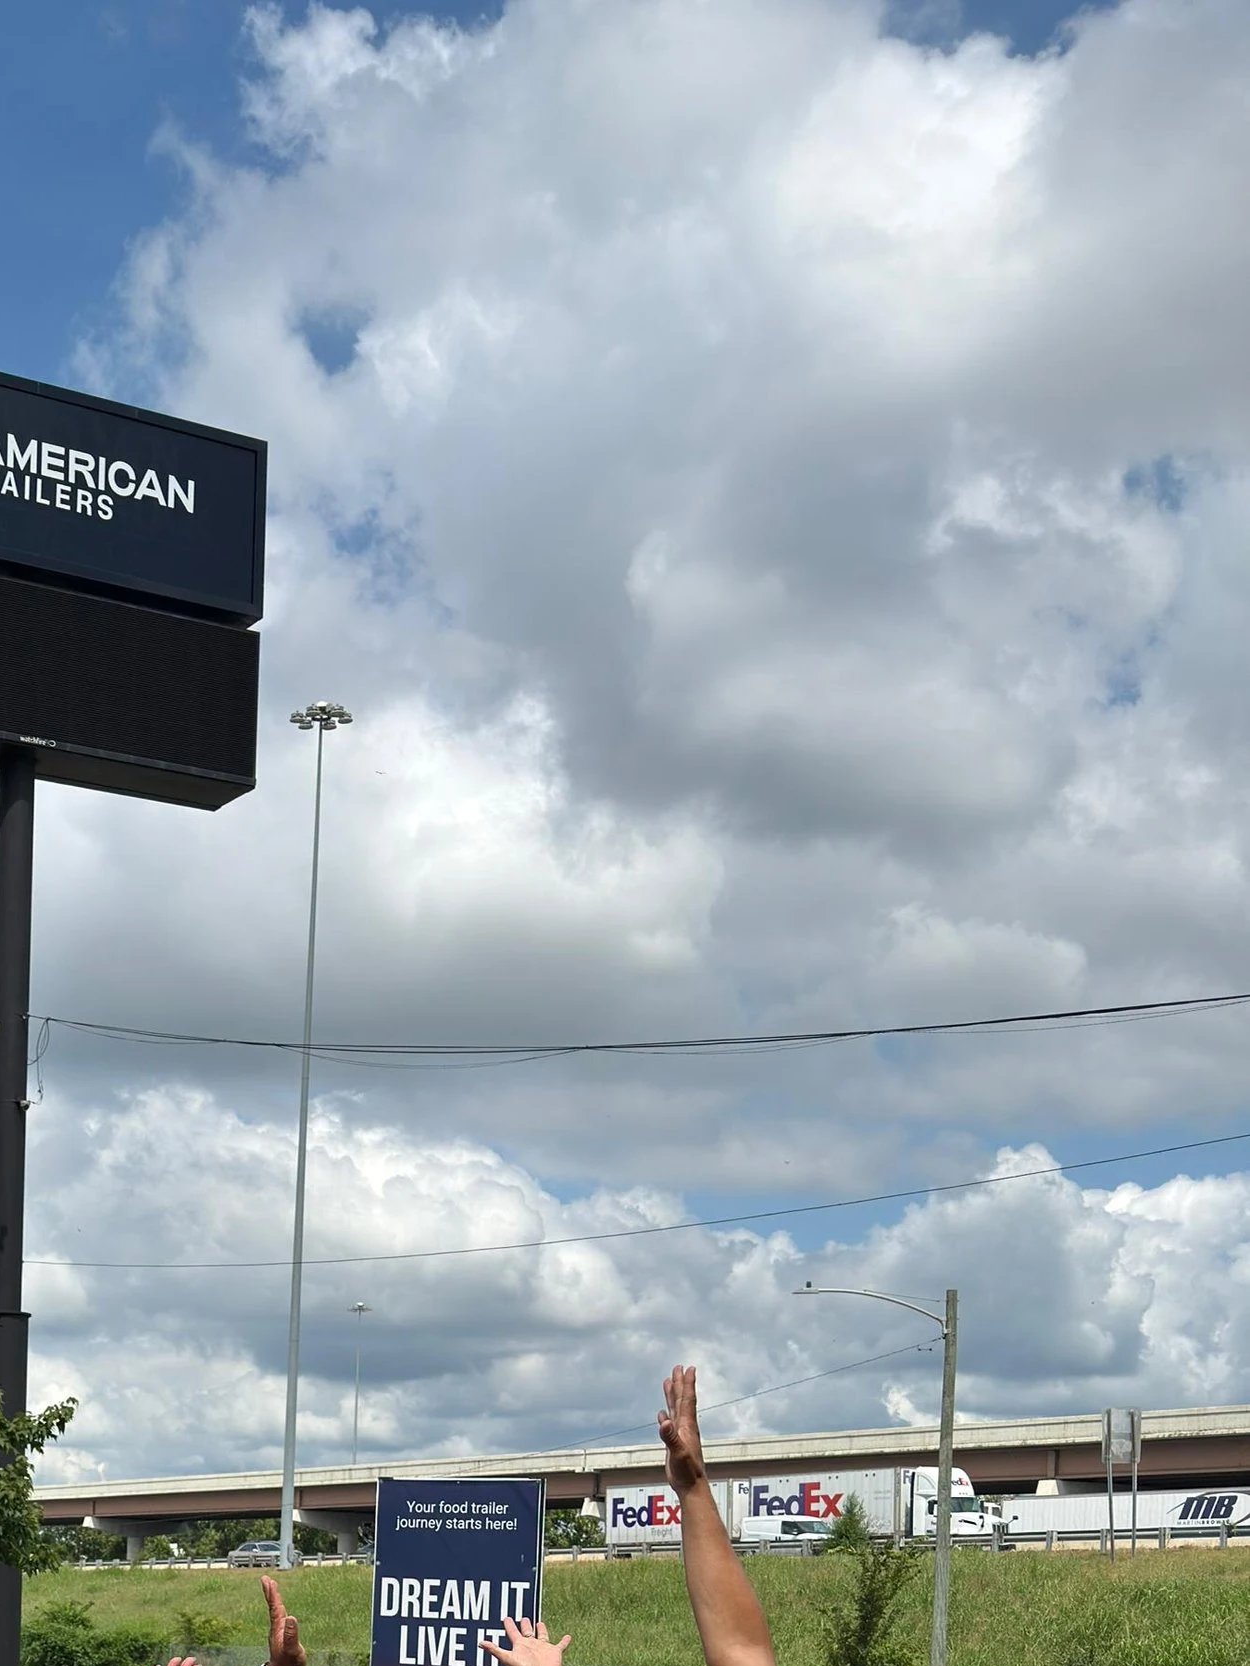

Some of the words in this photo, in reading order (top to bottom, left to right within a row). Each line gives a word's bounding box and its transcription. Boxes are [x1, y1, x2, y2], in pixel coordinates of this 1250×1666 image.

[406, 1500, 436, 1513] Your
[439, 1501, 468, 1514] food
[471, 1502, 509, 1515] trailer
[612, 1495, 681, 1528] FedEx
[753, 1482, 843, 1518] FedEx
[1178, 1495, 1238, 1520] MB
[395, 1516, 443, 1532] journey
[445, 1518, 483, 1530] starts
[485, 1517, 518, 1530] here!
[380, 1577, 490, 1621] DREAM
[500, 1581, 530, 1622] IT
